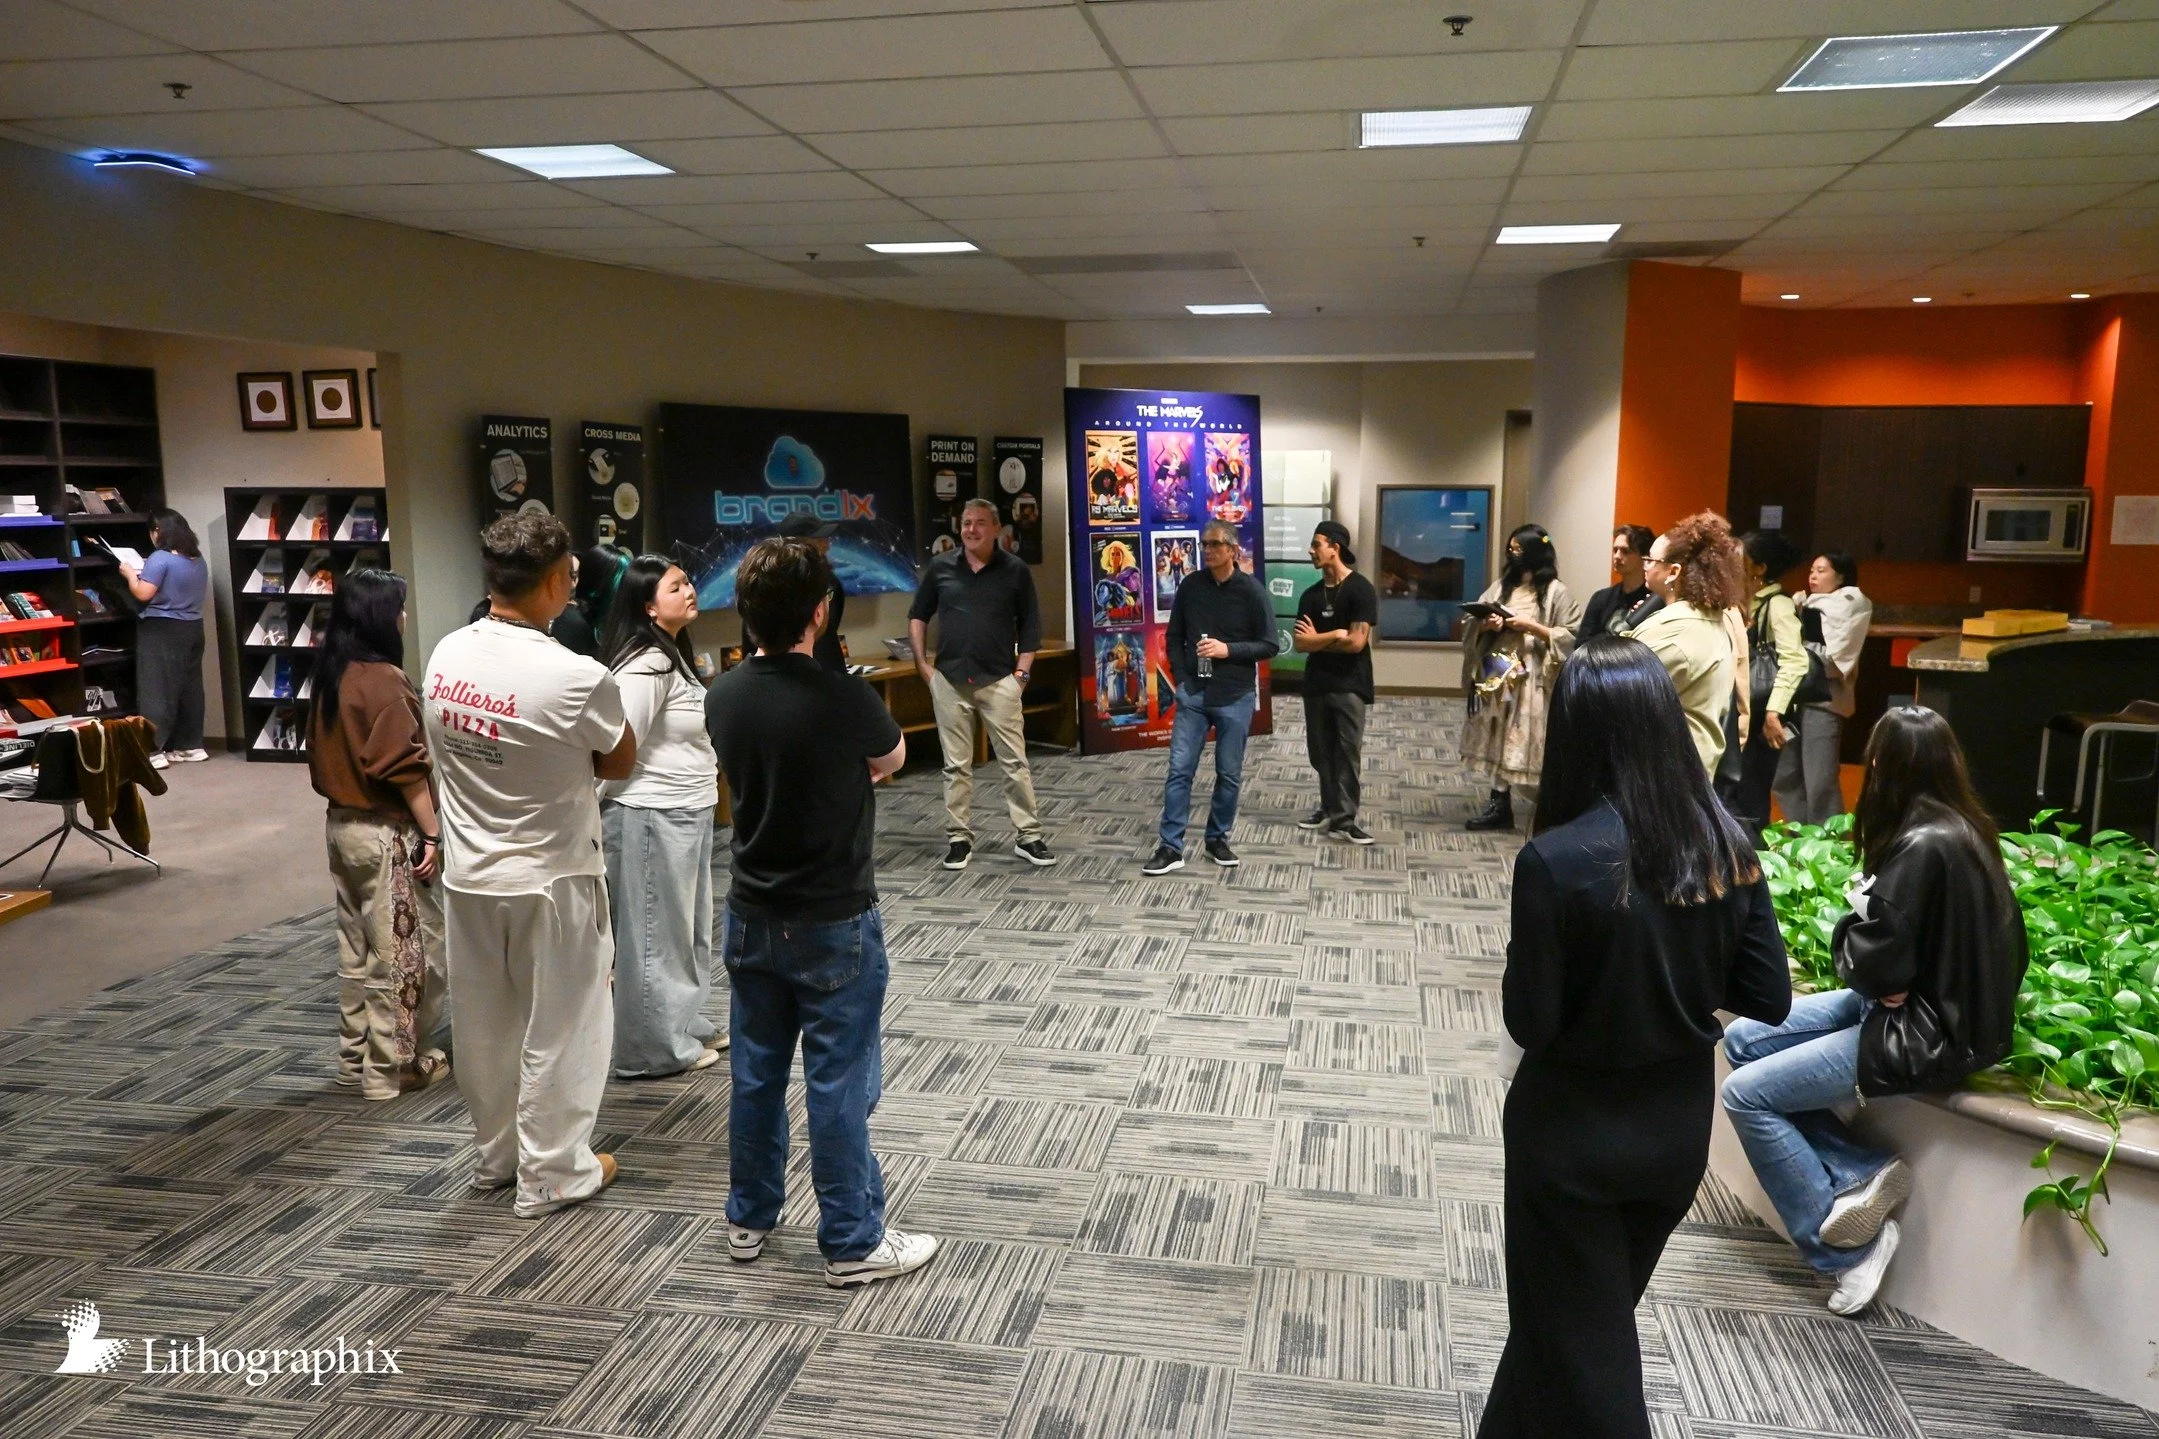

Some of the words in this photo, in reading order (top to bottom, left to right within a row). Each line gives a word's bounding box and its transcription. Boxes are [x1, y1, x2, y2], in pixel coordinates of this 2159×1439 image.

[1136, 405, 1158, 417] THE
[487, 424, 548, 438] ANALYTICS
[584, 428, 614, 439] CROSS
[615, 431, 641, 441] MEDIA
[931, 440, 958, 451] PRINT
[961, 442, 975, 451] ON
[931, 452, 975, 463] DEMAND
[429, 673, 520, 718] Folliero's
[443, 709, 499, 740] PIZZA
